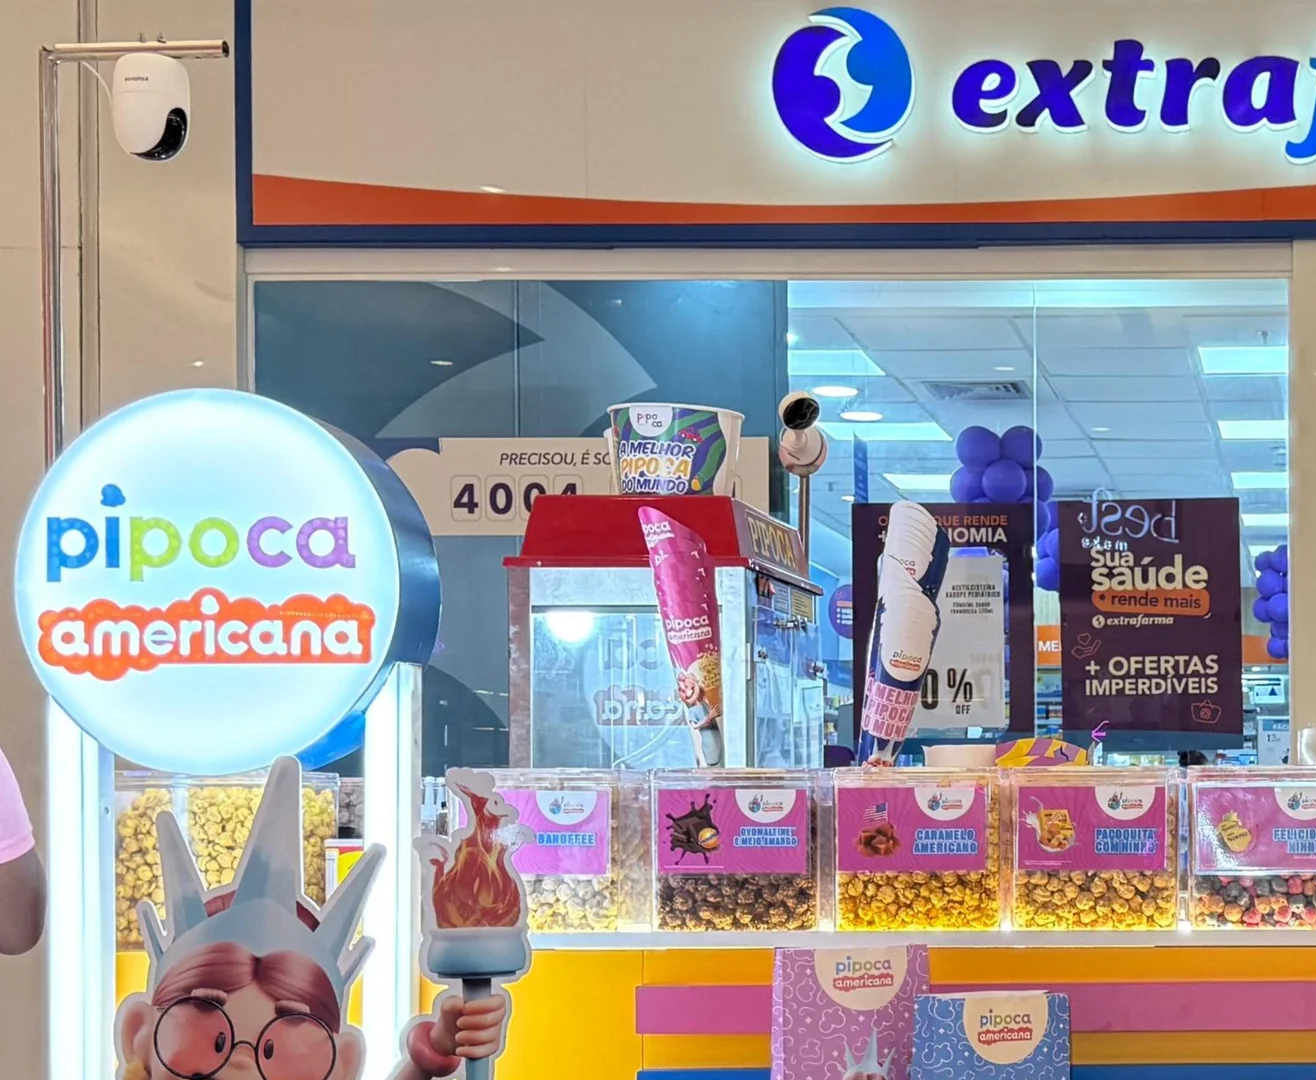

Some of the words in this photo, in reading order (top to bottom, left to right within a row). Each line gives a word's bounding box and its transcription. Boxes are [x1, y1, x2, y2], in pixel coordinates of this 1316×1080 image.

[500, 452, 577, 467] PRECISOU,
[581, 449, 591, 466] É
[629, 440, 696, 460] MELHOR
[635, 477, 688, 494] MUNDO
[963, 514, 1008, 526] RENDE
[46, 483, 356, 583] pipoca
[746, 514, 798, 569] PIPOCA
[1090, 547, 1135, 568] Sua
[1090, 553, 1209, 592] saúde
[1110, 593, 1159, 608] rende
[1163, 594, 1202, 610] mais
[51, 594, 363, 657] americana
[1106, 613, 1175, 628] extrafarma
[1107, 654, 1219, 677] OFERTAS
[946, 667, 974, 704] %
[1085, 673, 1219, 697] IMPERDÍVEIS
[955, 705, 971, 715] OFF
[537, 832, 596, 846] BANOFFEE
[915, 828, 976, 841] CARAMELO
[913, 841, 978, 855] AMERICANO
[1094, 841, 1119, 854] COM
[1120, 841, 1157, 854] NINHO
[835, 956, 892, 976] pipoca
[834, 975, 894, 990] americana
[979, 1009, 1032, 1028] pipoca
[979, 1028, 1033, 1043] americana
